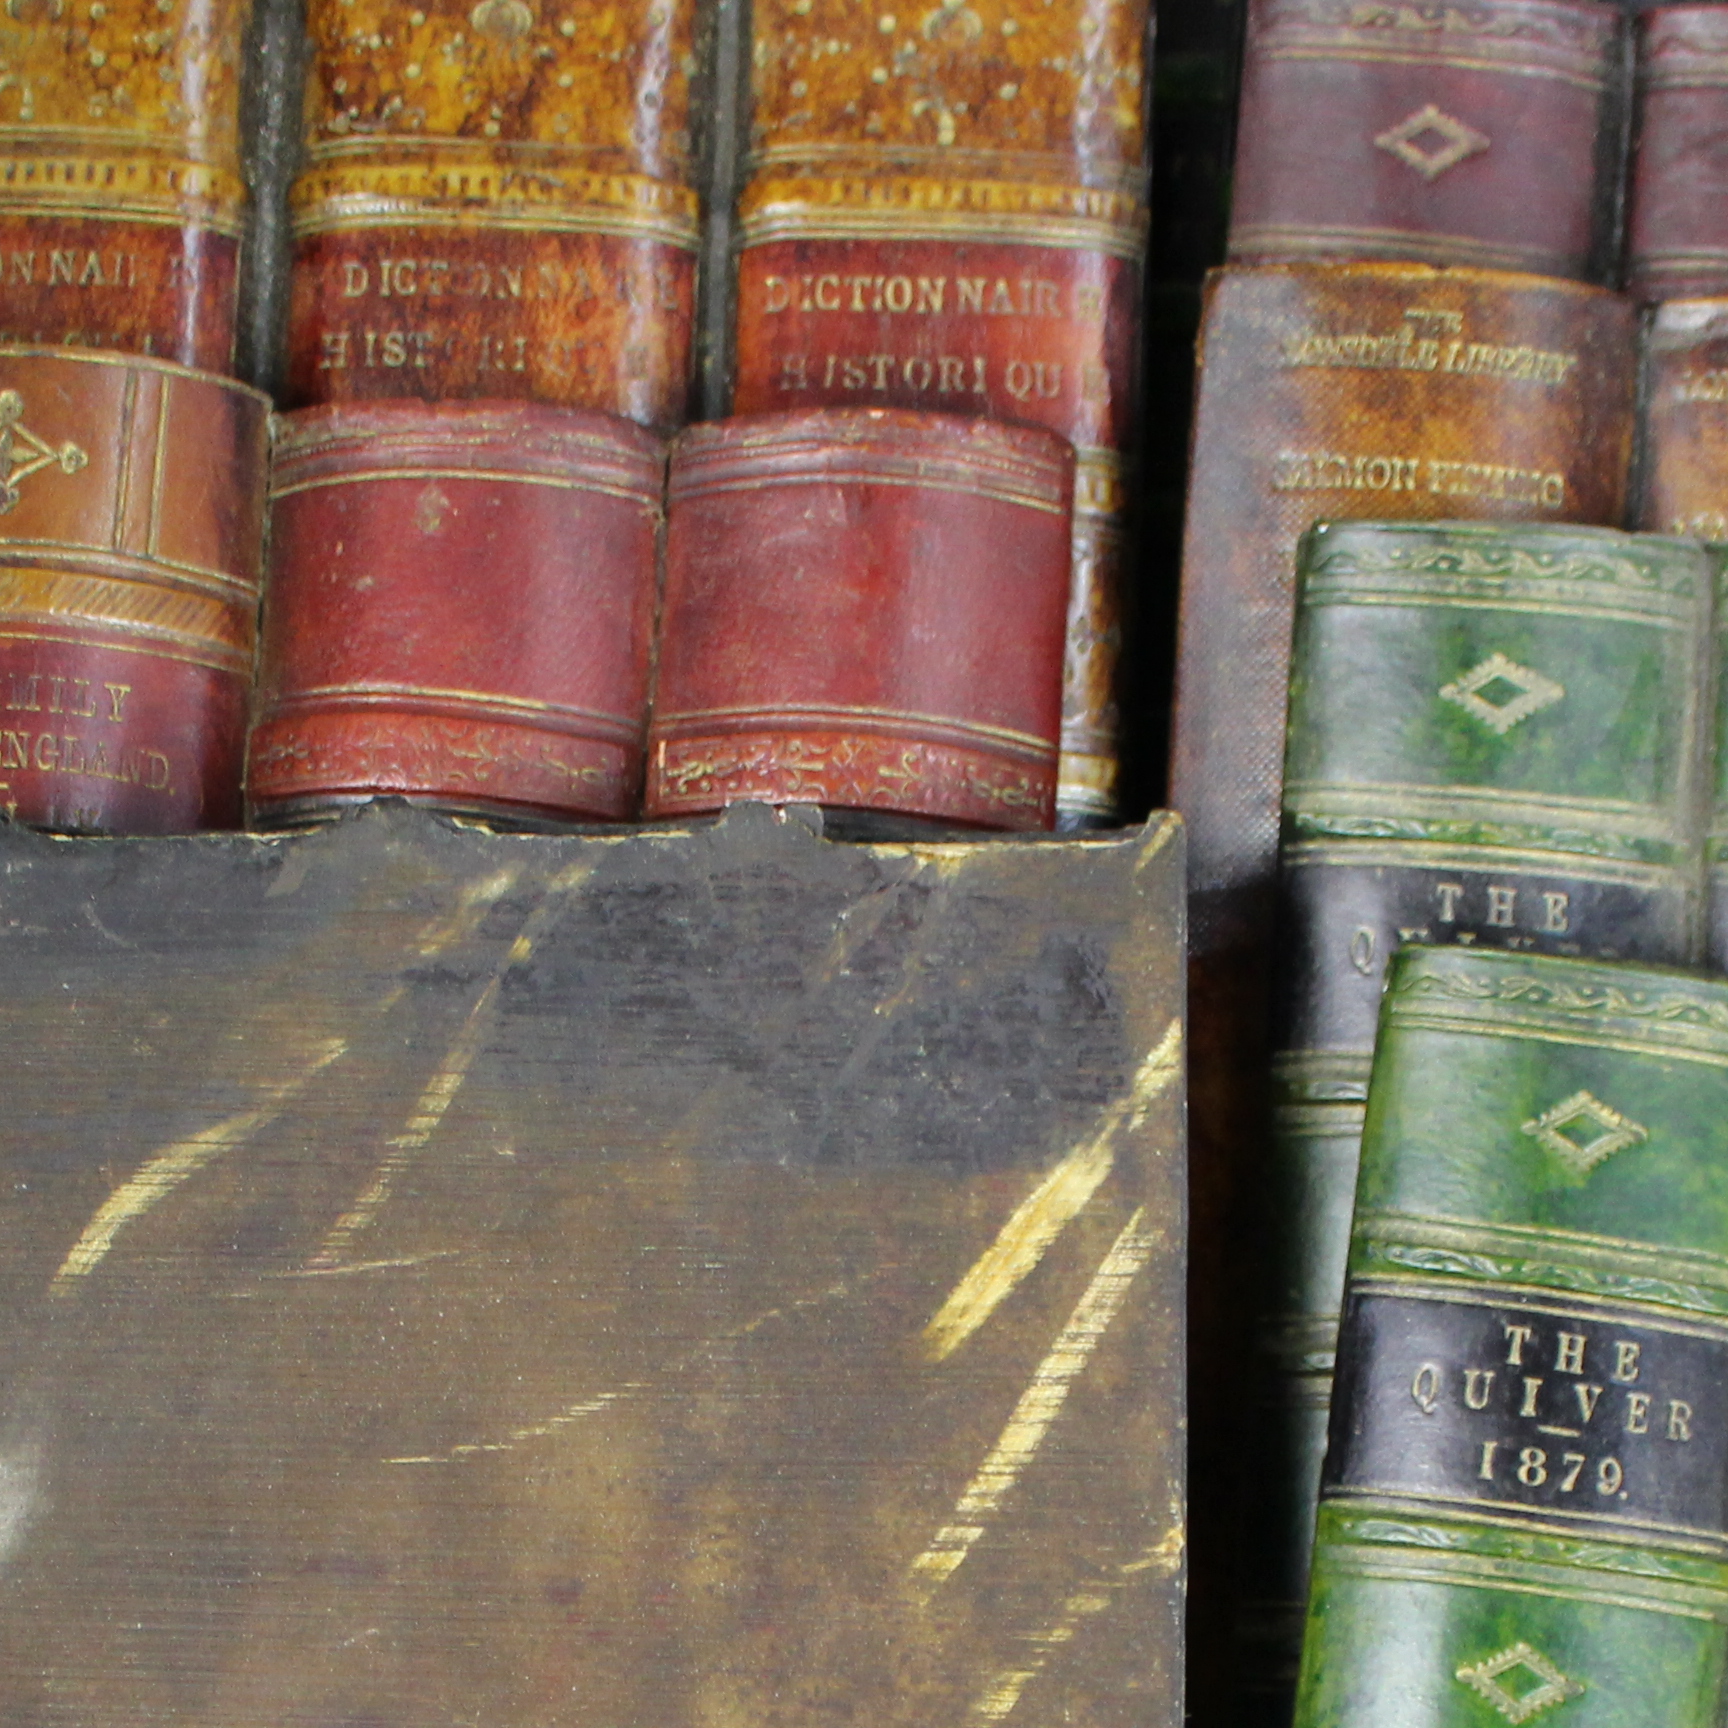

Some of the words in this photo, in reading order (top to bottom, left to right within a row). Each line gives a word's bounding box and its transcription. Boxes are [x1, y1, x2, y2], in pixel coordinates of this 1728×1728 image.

[1436, 881, 1571, 933] THE
[1503, 1322, 1643, 1384] THE
[1411, 1361, 1694, 1443] QUIVER
[1477, 1439, 1629, 1501] 1879.
